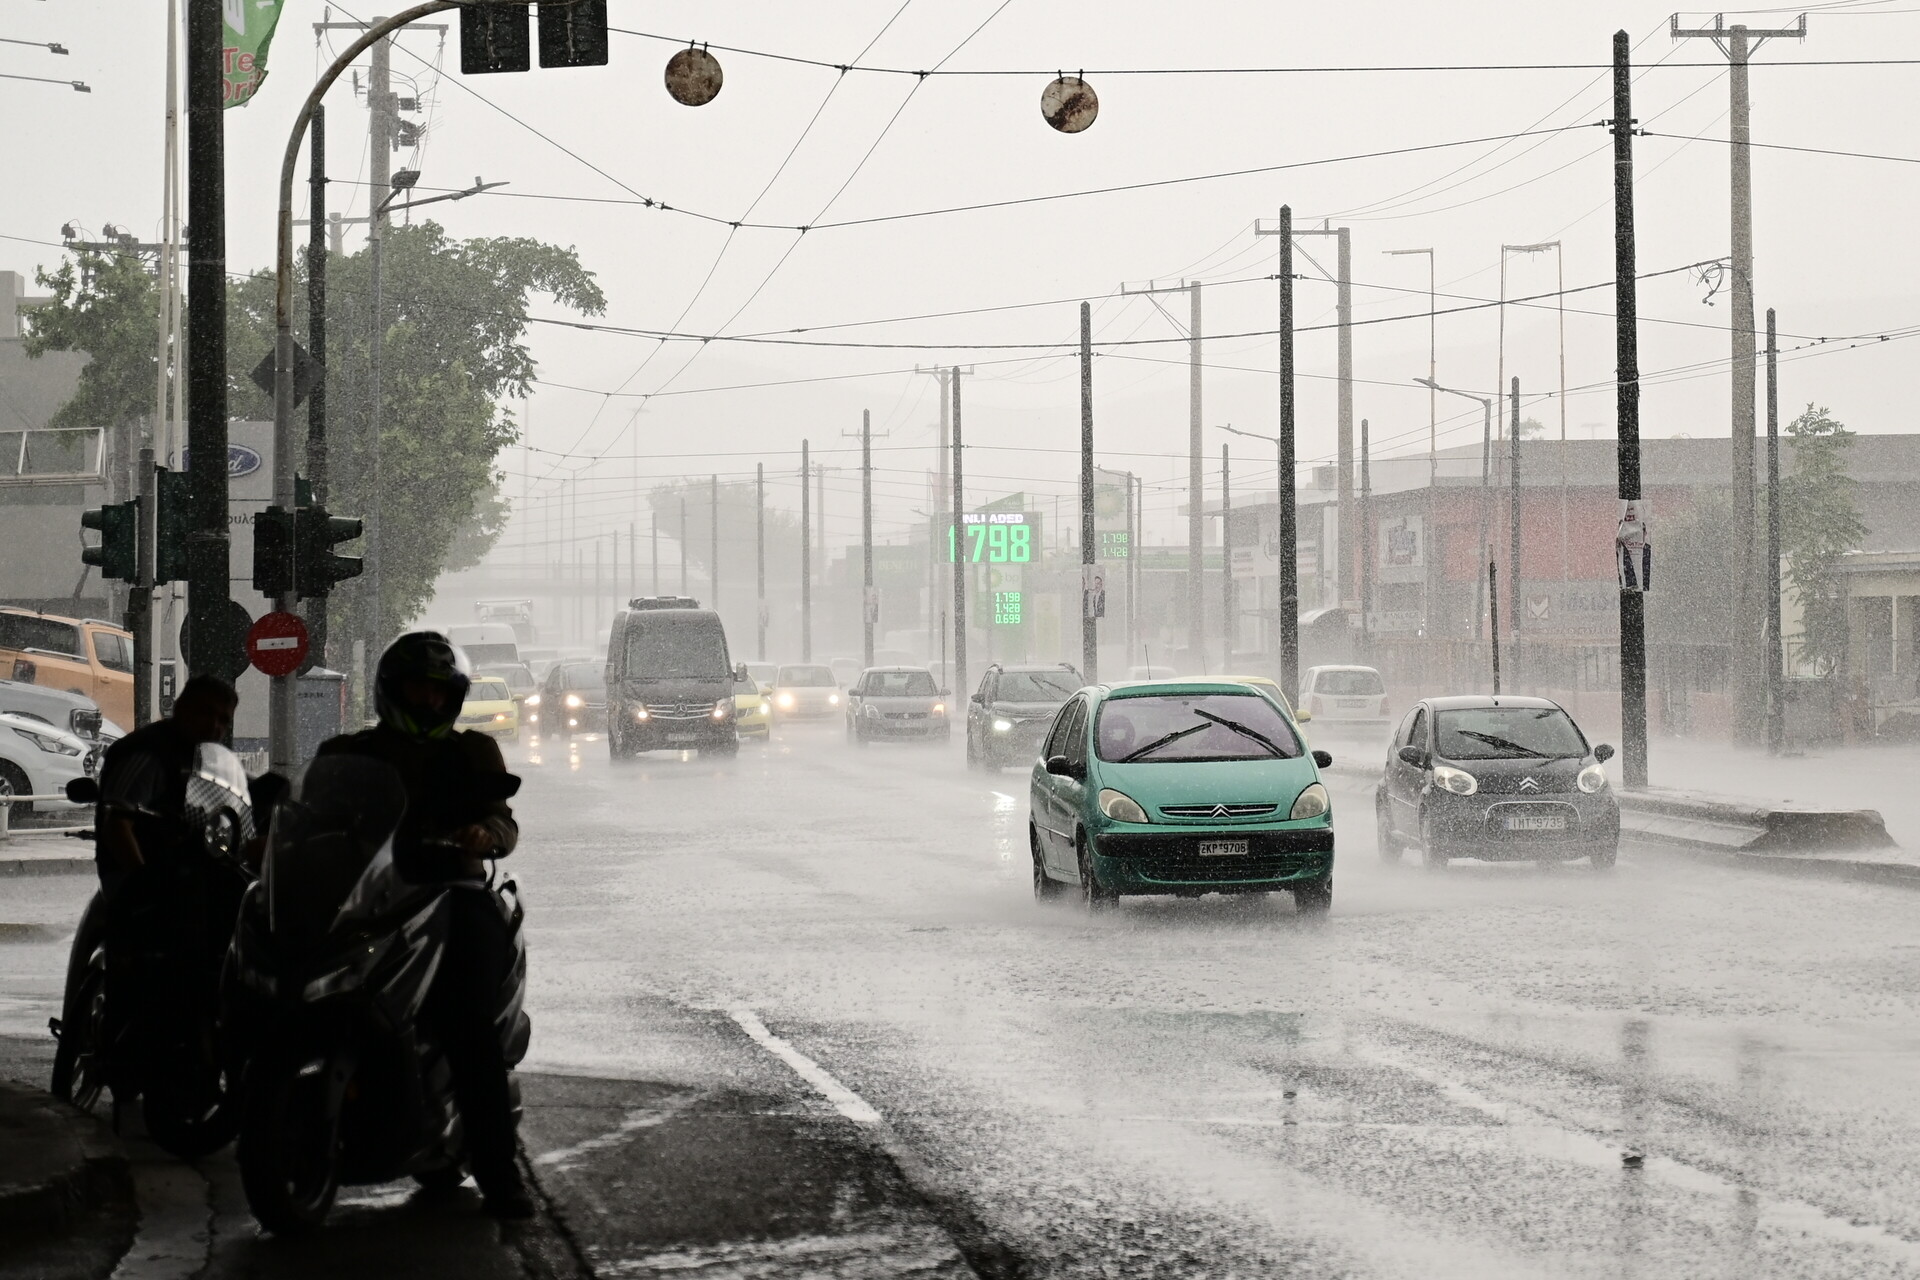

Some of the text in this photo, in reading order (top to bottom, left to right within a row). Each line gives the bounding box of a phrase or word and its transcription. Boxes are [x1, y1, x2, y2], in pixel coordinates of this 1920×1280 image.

[962, 513, 1024, 524] NLADED
[995, 592, 1021, 602] 1.798
[995, 603, 1021, 613] 1.428
[995, 614, 1021, 624] 0.699
